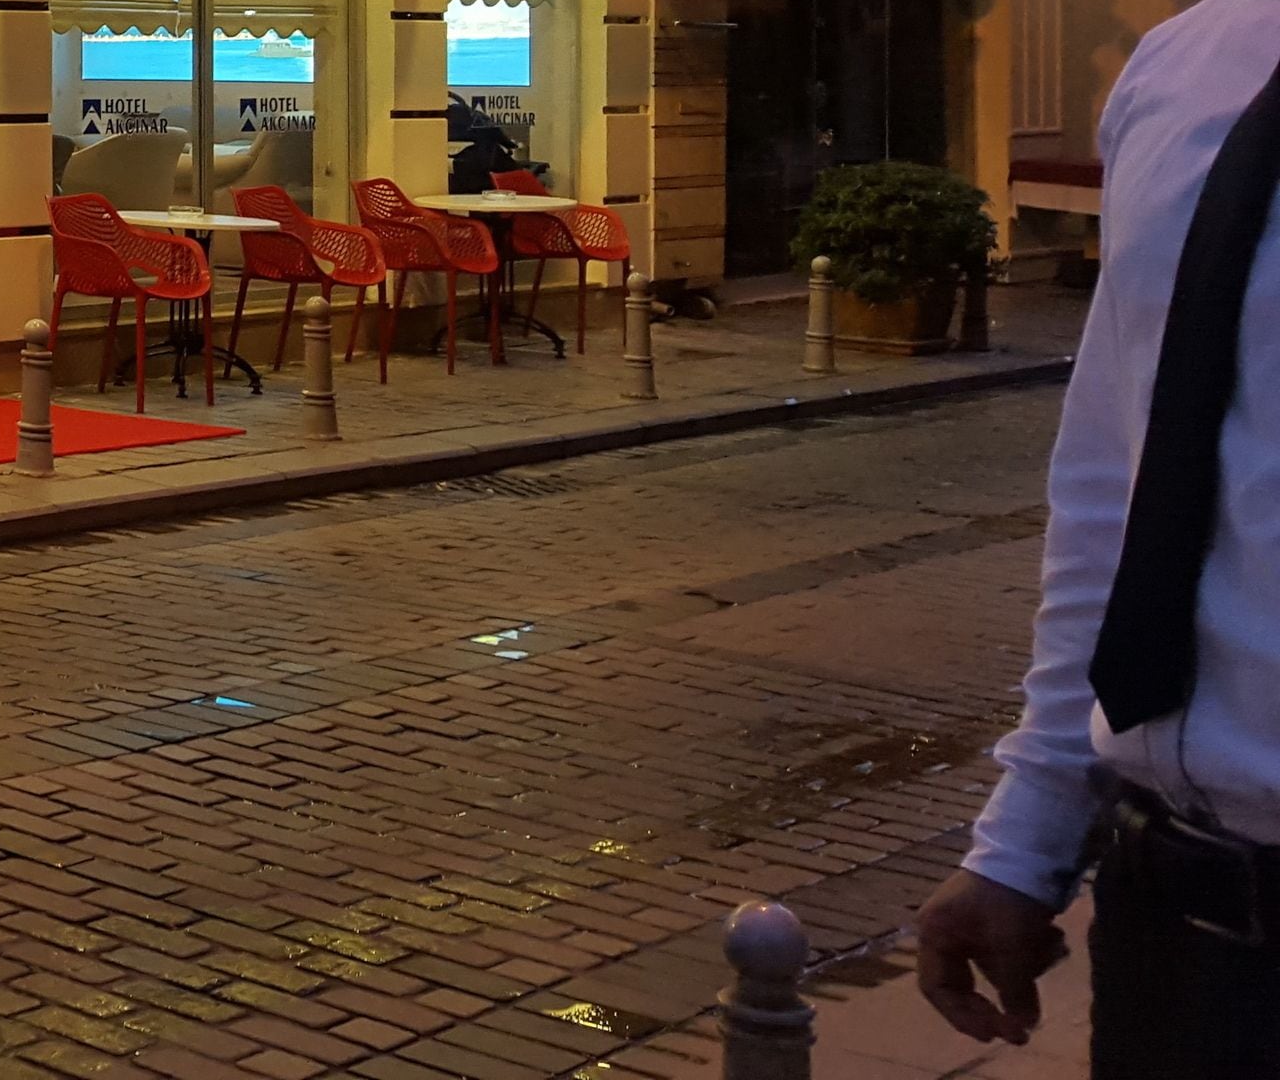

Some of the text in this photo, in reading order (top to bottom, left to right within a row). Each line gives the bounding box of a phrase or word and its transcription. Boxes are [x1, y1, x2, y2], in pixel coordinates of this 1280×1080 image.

[105, 98, 148, 114] HOTEL
[260, 97, 299, 113] HOTEL
[488, 95, 521, 110] HOTEL
